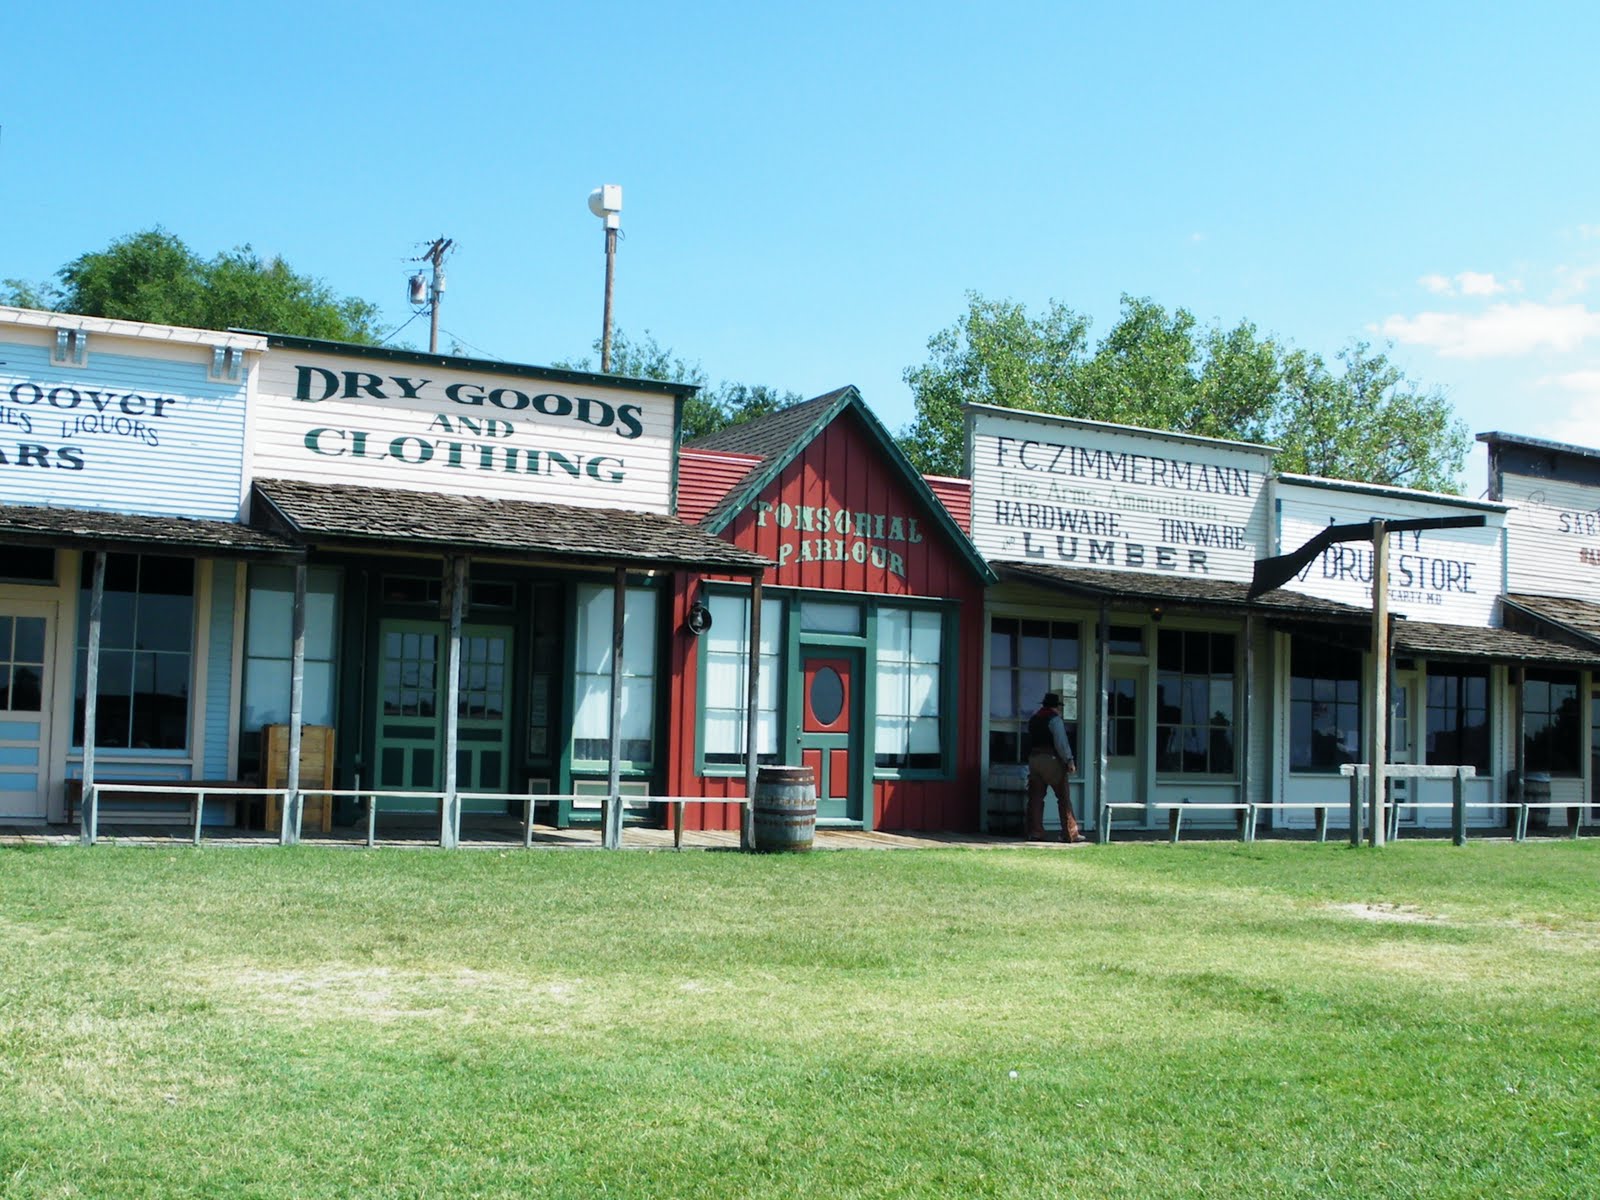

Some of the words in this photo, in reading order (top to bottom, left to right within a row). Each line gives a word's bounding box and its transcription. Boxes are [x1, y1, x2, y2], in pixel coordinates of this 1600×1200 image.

[9, 382, 176, 418] oover
[292, 365, 432, 402] DRY
[445, 383, 643, 440] GOODS
[62, 413, 159, 447] LIQUORS
[427, 414, 515, 439] AND
[303, 428, 627, 484] CLOTHING
[1046, 443, 1251, 497] ZIMMERMANN
[751, 500, 923, 544] TONSORIAL
[994, 499, 1129, 540] HARDWARE,
[773, 537, 906, 579] PARLOUR
[1022, 532, 1210, 574] LUMBER
[1322, 545, 1391, 584] DRU
[1399, 554, 1477, 594] STORE
